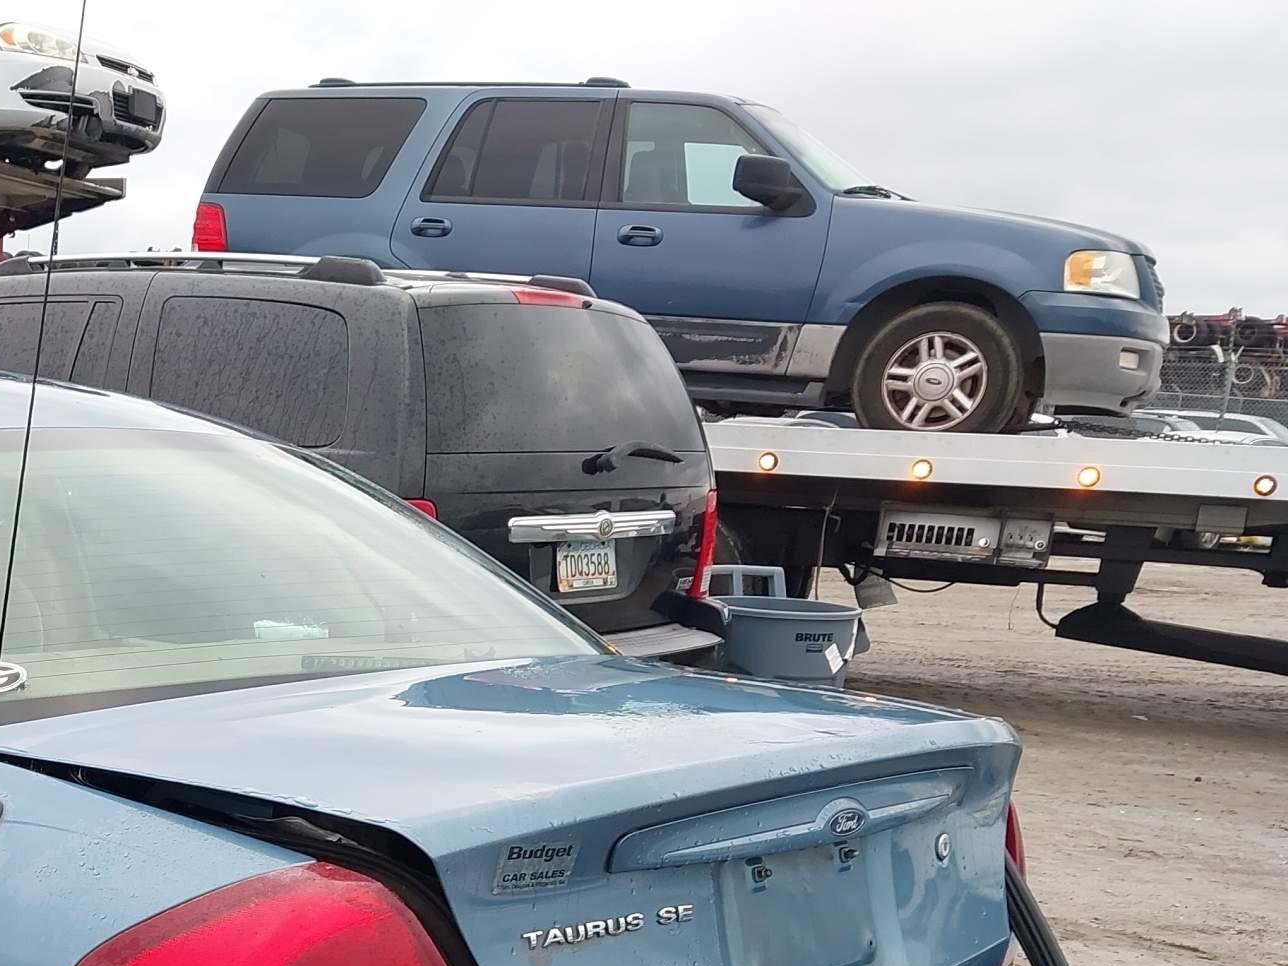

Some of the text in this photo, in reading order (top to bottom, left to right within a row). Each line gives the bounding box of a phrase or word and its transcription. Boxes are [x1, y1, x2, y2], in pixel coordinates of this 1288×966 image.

[562, 552, 610, 578] TDQ3588
[795, 633, 834, 642] BRUTE
[836, 811, 859, 833] Ford
[508, 845, 573, 862] Budget
[502, 869, 565, 883] CAR SALES
[522, 904, 694, 950] TAURUS SE
